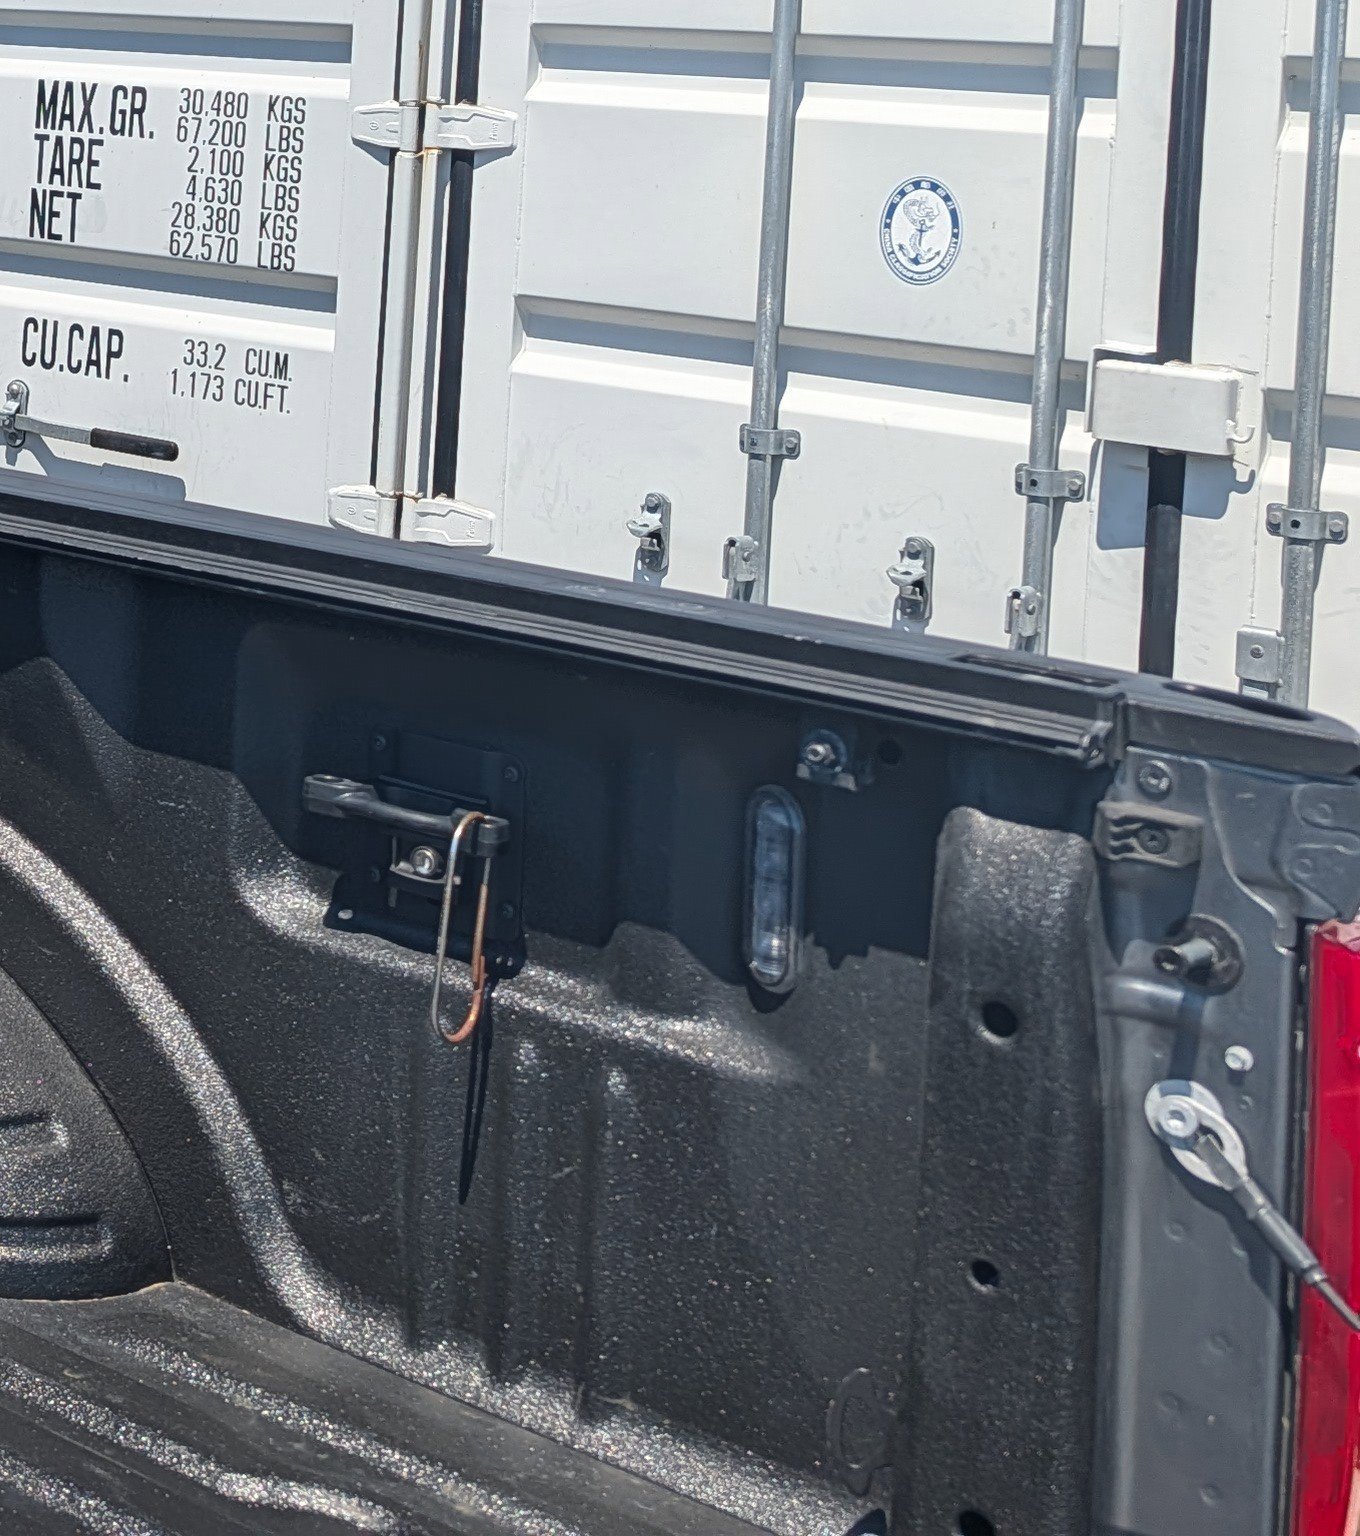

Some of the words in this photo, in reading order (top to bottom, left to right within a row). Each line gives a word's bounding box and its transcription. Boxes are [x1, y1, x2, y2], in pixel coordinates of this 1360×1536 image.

[179, 87, 249, 119] 30,480
[267, 94, 307, 124] KGS
[176, 116, 247, 148] 67,200
[265, 124, 304, 154] LBS
[34, 133, 104, 190] TARE
[187, 145, 245, 178] 2,100
[263, 153, 302, 183] KGS
[185, 174, 242, 206] 4,630
[261, 182, 300, 213] LBS
[29, 187, 82, 243] NET
[171, 201, 241, 235] 28,380
[258, 211, 298, 242] KGS
[169, 230, 239, 265] 62,570
[256, 241, 296, 272] LBS
[183, 338, 226, 371] 33.2
[244, 348, 292, 382] CU.M.
[171, 367, 225, 402] 1,173
[234, 378, 291, 414] CU.FT.
